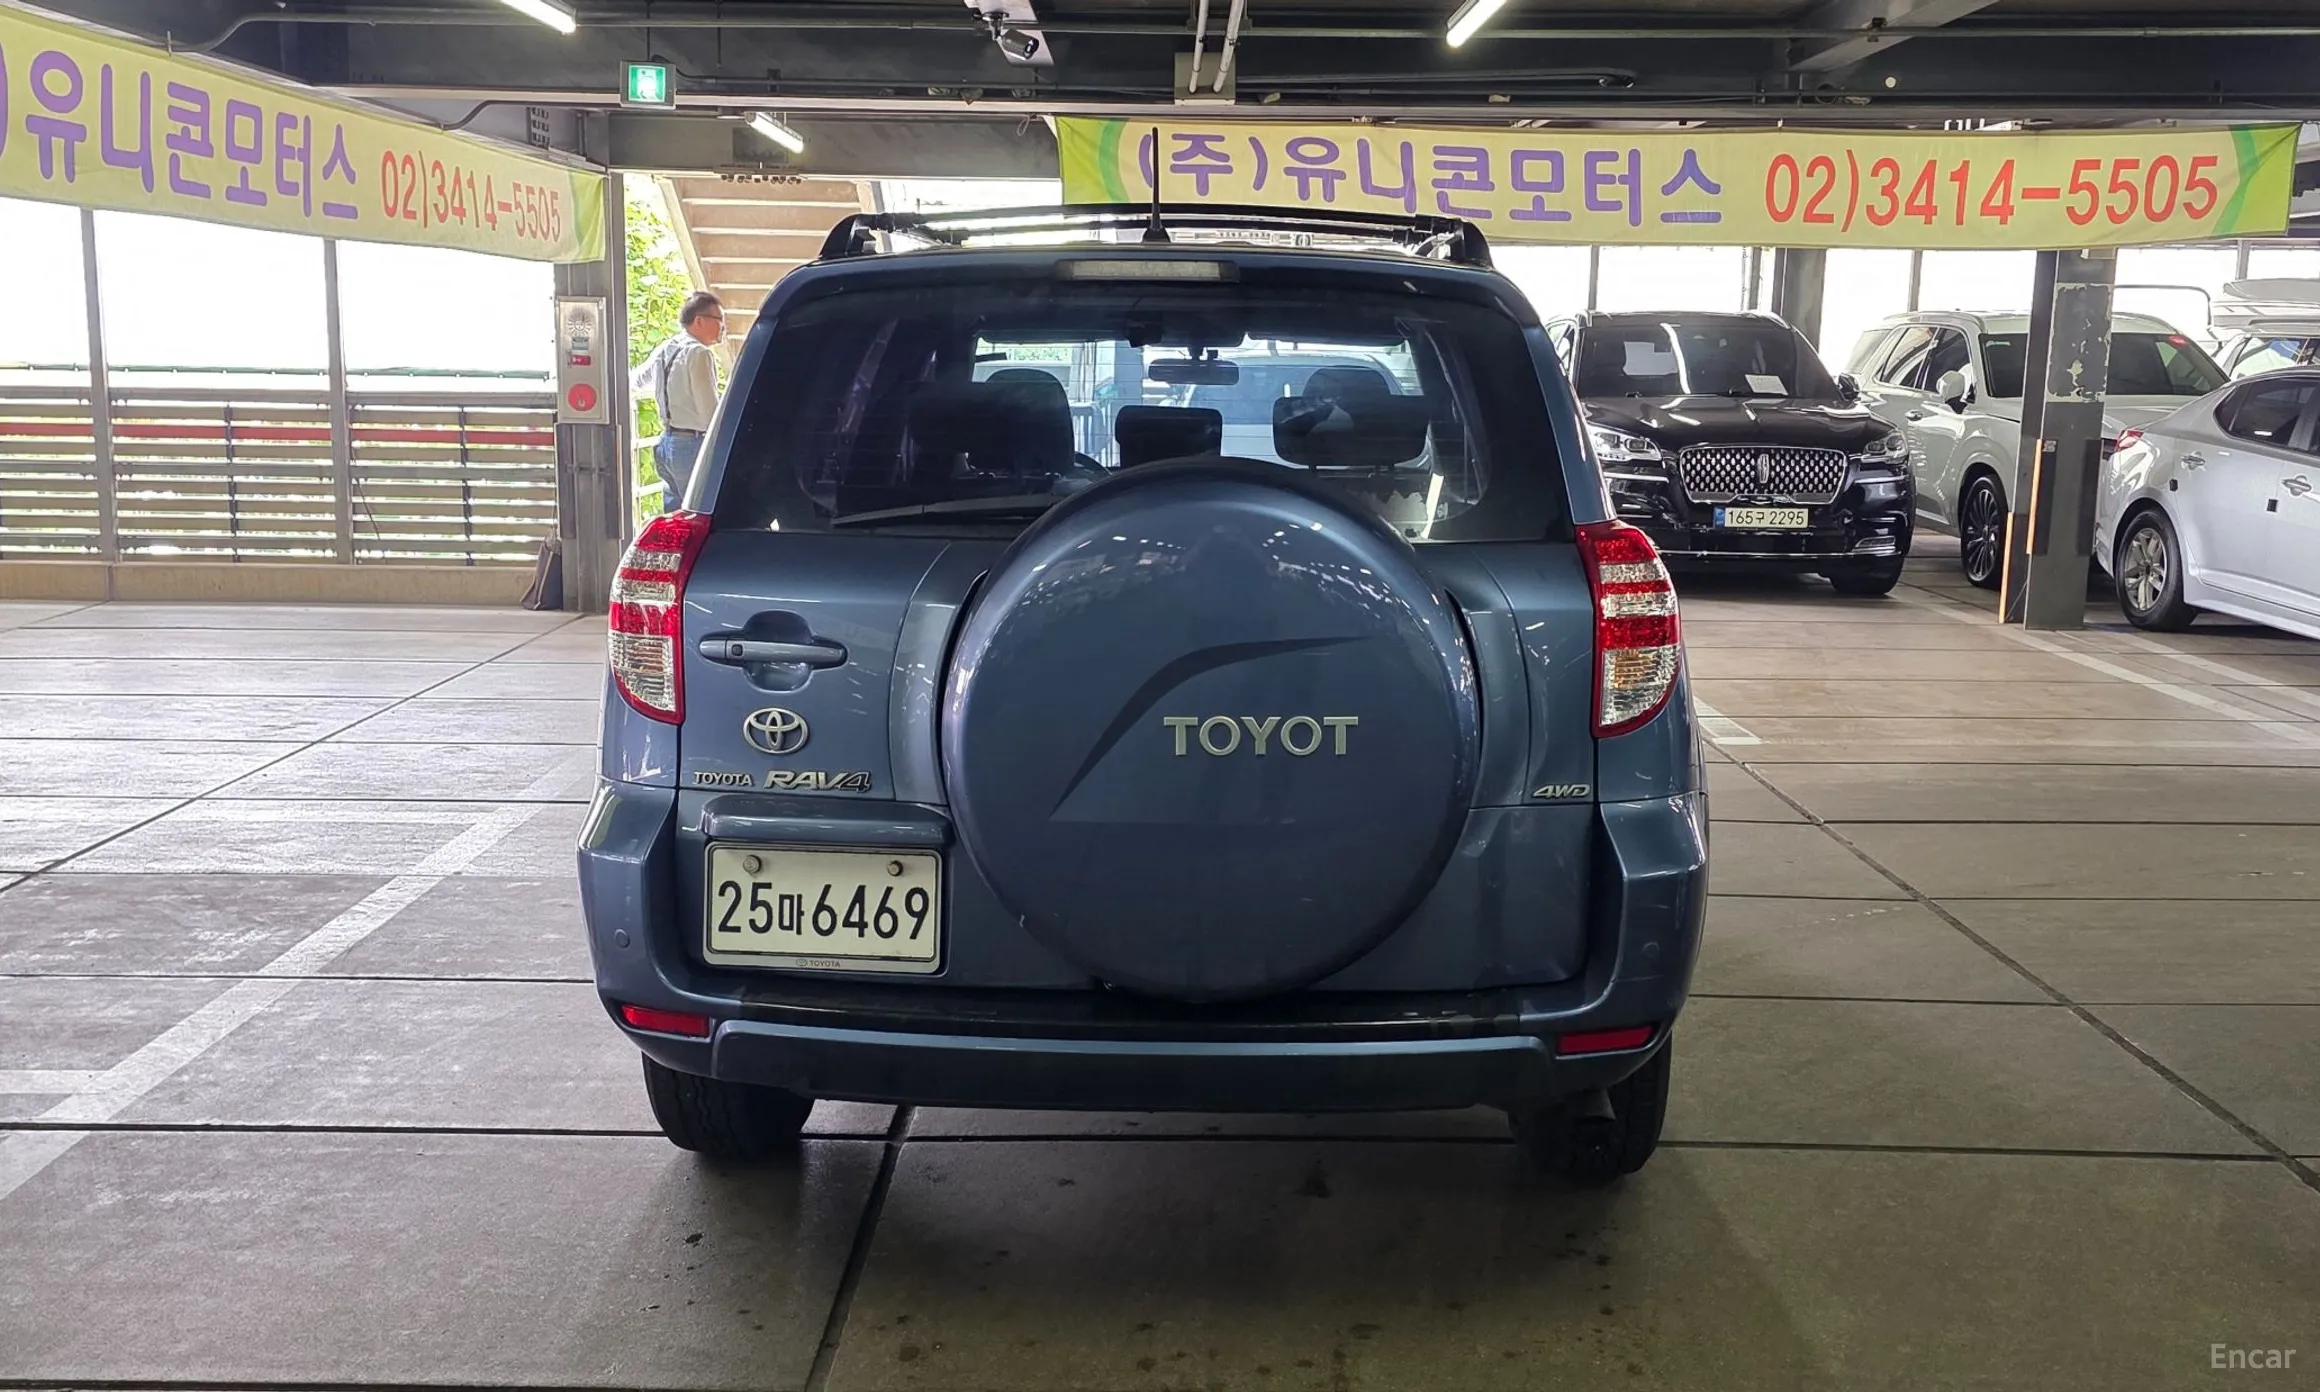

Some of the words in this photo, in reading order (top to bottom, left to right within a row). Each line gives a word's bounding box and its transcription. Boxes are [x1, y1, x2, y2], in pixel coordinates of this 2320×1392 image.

[381, 150, 561, 243] 02)3414-5505
[1138, 132, 1722, 228] (주)유니콘모터스
[1765, 149, 2219, 232] 02)3414-5505
[1728, 510, 1765, 525] 165구
[1769, 510, 1805, 525] 2295
[1163, 715, 1359, 756] TOYOT
[693, 771, 753, 786] TOYOTA
[763, 770, 872, 793] RAV4
[1533, 783, 1591, 799] 4WD
[717, 880, 930, 940] 25마6469
[808, 959, 841, 968] TOYOTA
